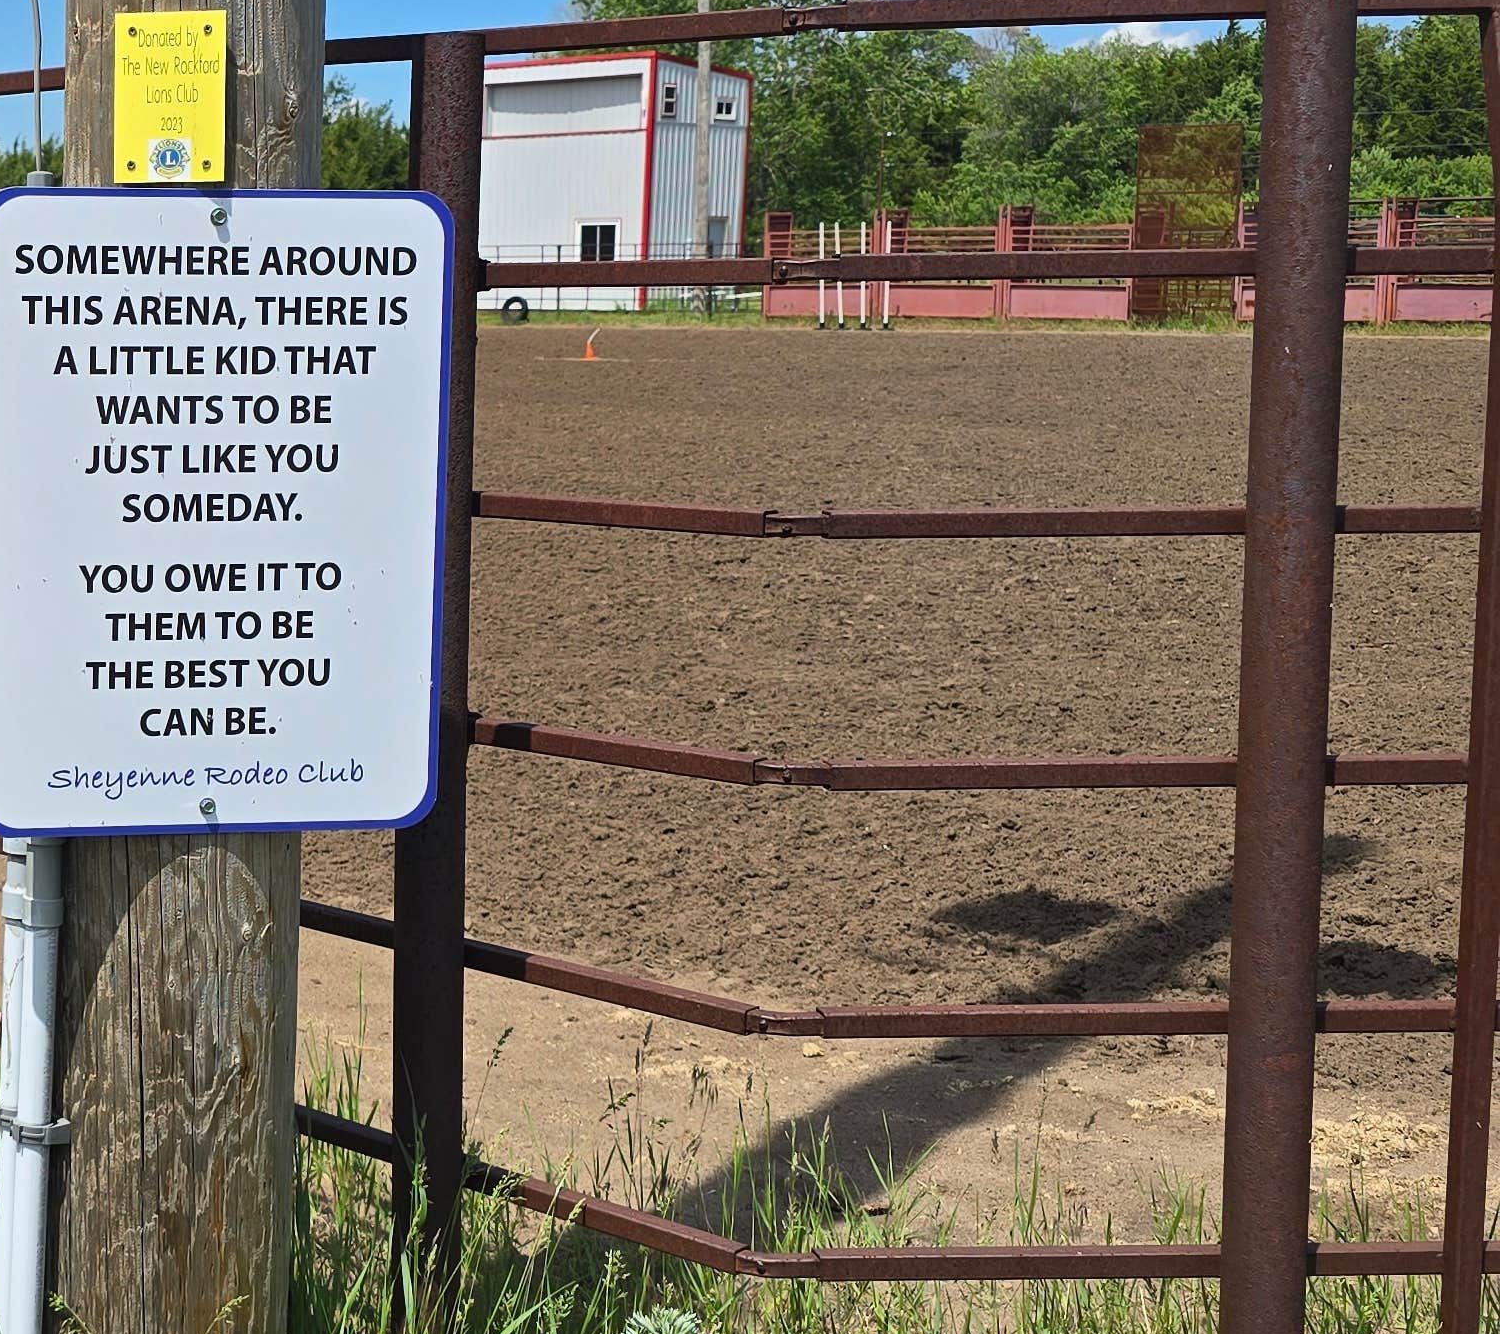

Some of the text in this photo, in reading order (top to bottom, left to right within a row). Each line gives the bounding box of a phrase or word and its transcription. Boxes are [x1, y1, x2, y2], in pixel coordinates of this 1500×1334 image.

[139, 27, 198, 53] Donated by
[122, 54, 219, 76] The New Rockford
[147, 83, 198, 103] Lions Club
[160, 117, 182, 133] 2023
[16, 245, 416, 275] SOMEWHERE AROUND
[22, 295, 407, 331] THIS ARENA, THERE IS
[54, 346, 376, 374] A LITTLE KID THAT
[96, 395, 331, 424] WANTS TO BE
[85, 444, 338, 474] JUST LIKE YOU
[123, 493, 302, 522] SOMEDAY.
[80, 562, 341, 593] YOU OWE IT TO
[105, 611, 313, 641] THEM TO BE
[86, 659, 330, 689] THE BEST YOU
[140, 707, 276, 736] CAN BE.
[48, 759, 363, 800] Sheyenne Rodeo Club
